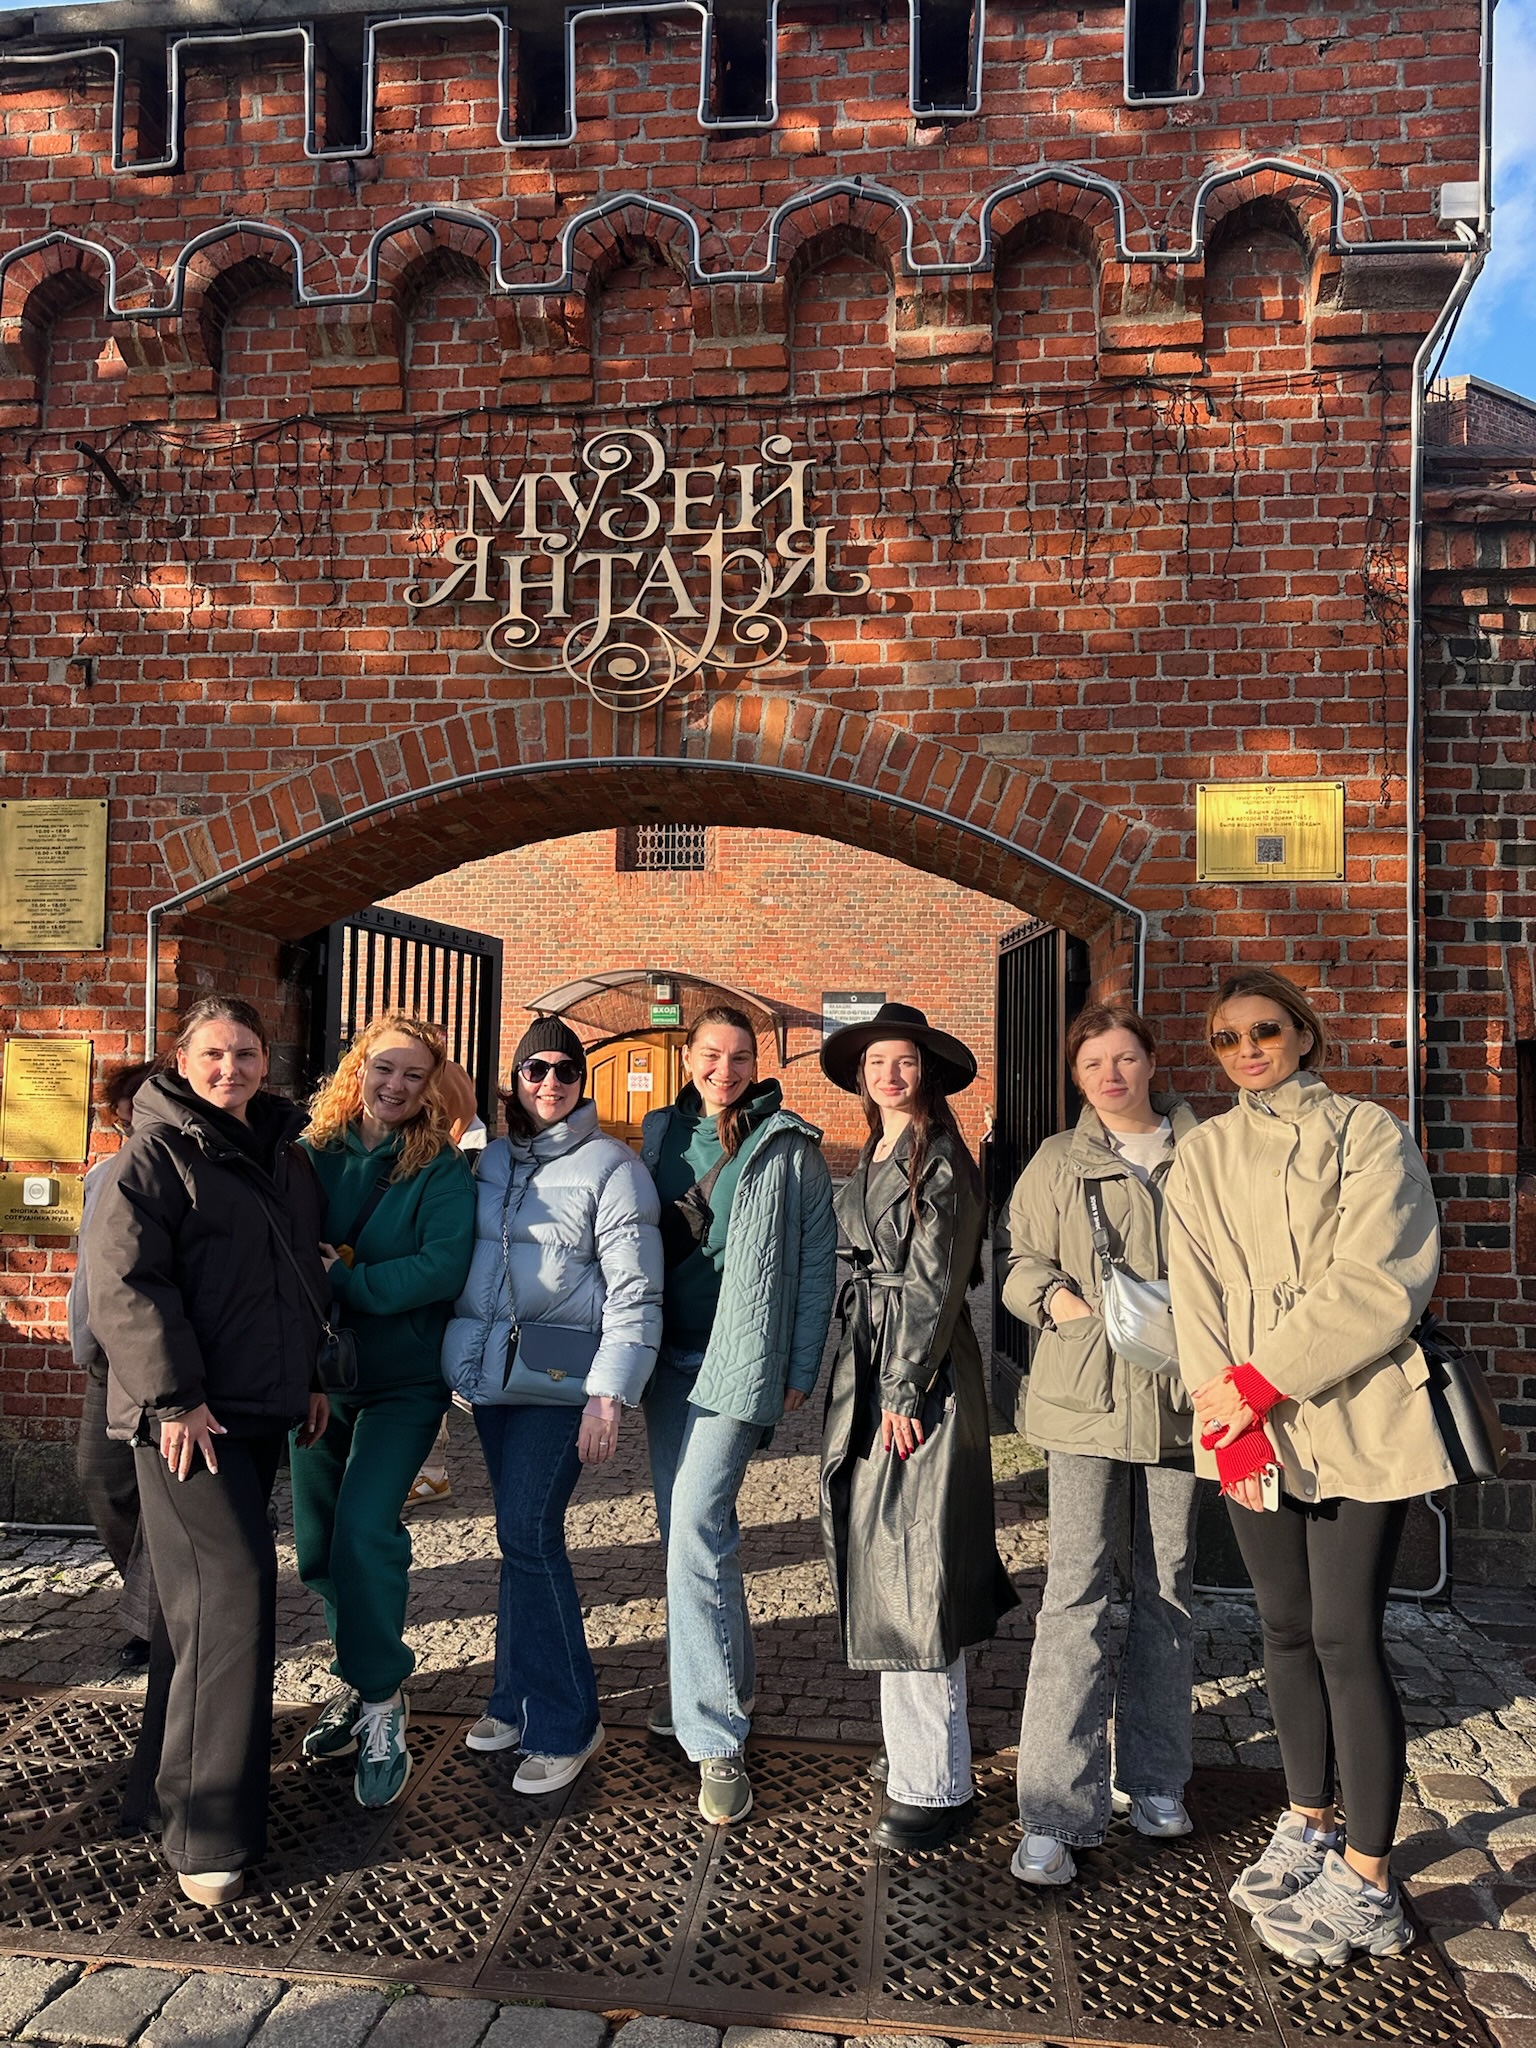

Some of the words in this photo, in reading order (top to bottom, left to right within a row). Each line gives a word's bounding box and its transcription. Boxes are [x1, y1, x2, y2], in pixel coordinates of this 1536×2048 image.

[462, 428, 817, 556] МУЗЕЙ
[403, 513, 871, 712] ЯНТАРЯ
[653, 1006, 677, 1014] ВХОД
